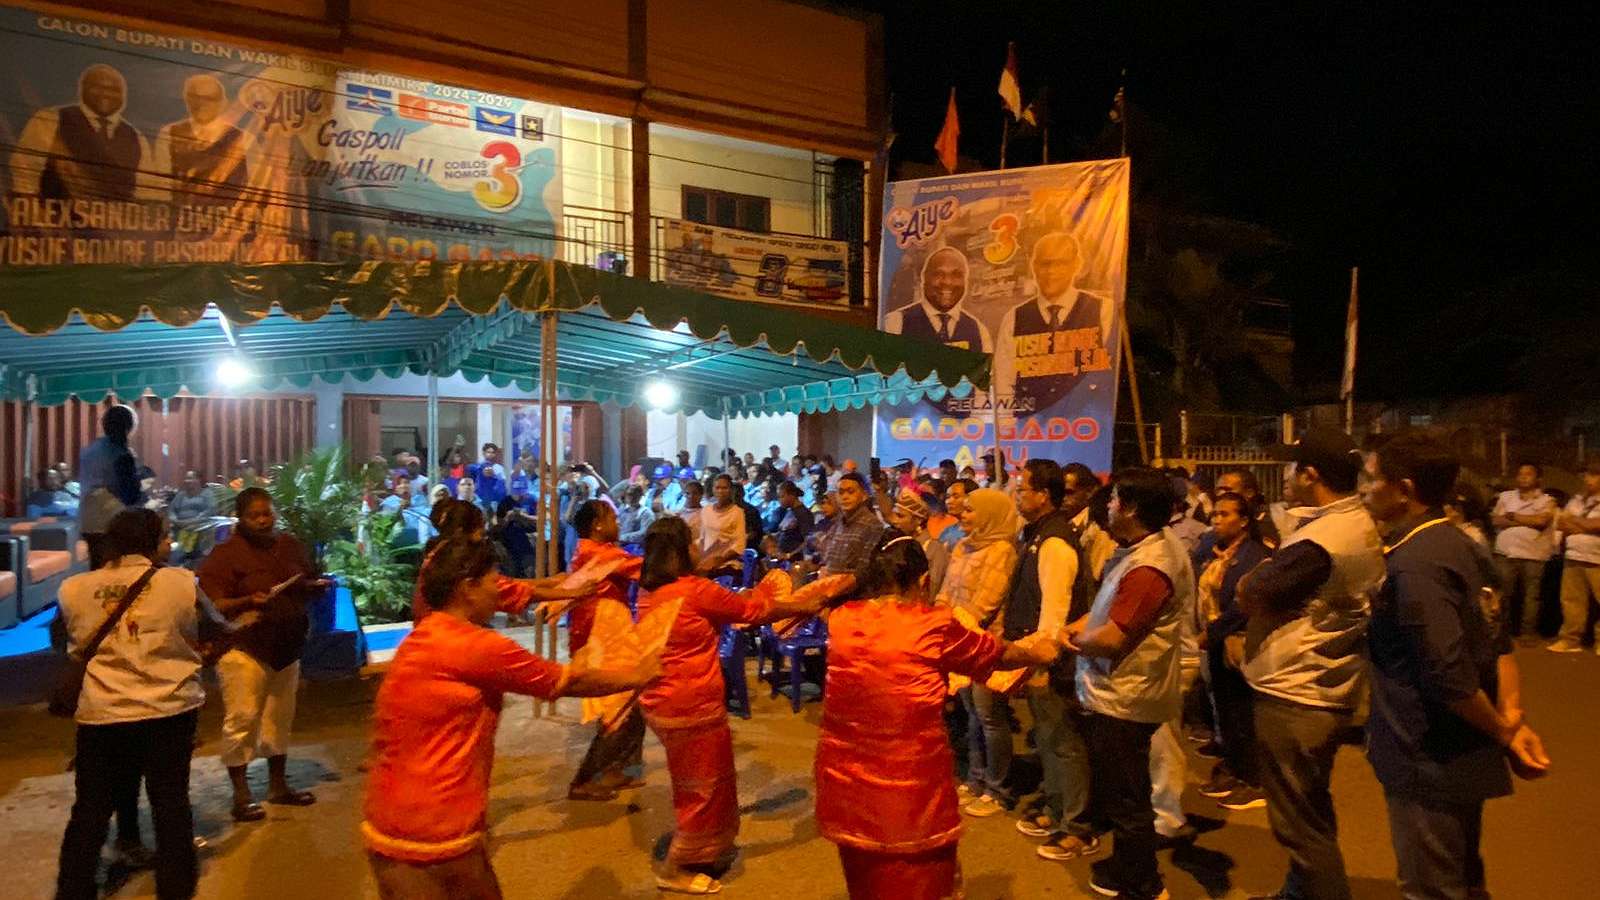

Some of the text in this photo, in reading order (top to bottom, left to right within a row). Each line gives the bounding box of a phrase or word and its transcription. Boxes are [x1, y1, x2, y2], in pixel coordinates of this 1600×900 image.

[37, 15, 109, 39] CALON
[114, 28, 184, 51] BUPATI
[191, 39, 231, 59] DAN
[434, 84, 513, 109] 2024-2029
[317, 119, 406, 155] Gaspoll
[444, 160, 488, 169] COBLOS
[474, 141, 522, 210] 3
[901, 200, 954, 244] Aiye
[983, 213, 1019, 264] 3
[947, 396, 1036, 412] RELAWAN
[890, 417, 1100, 442] GADO GADO
